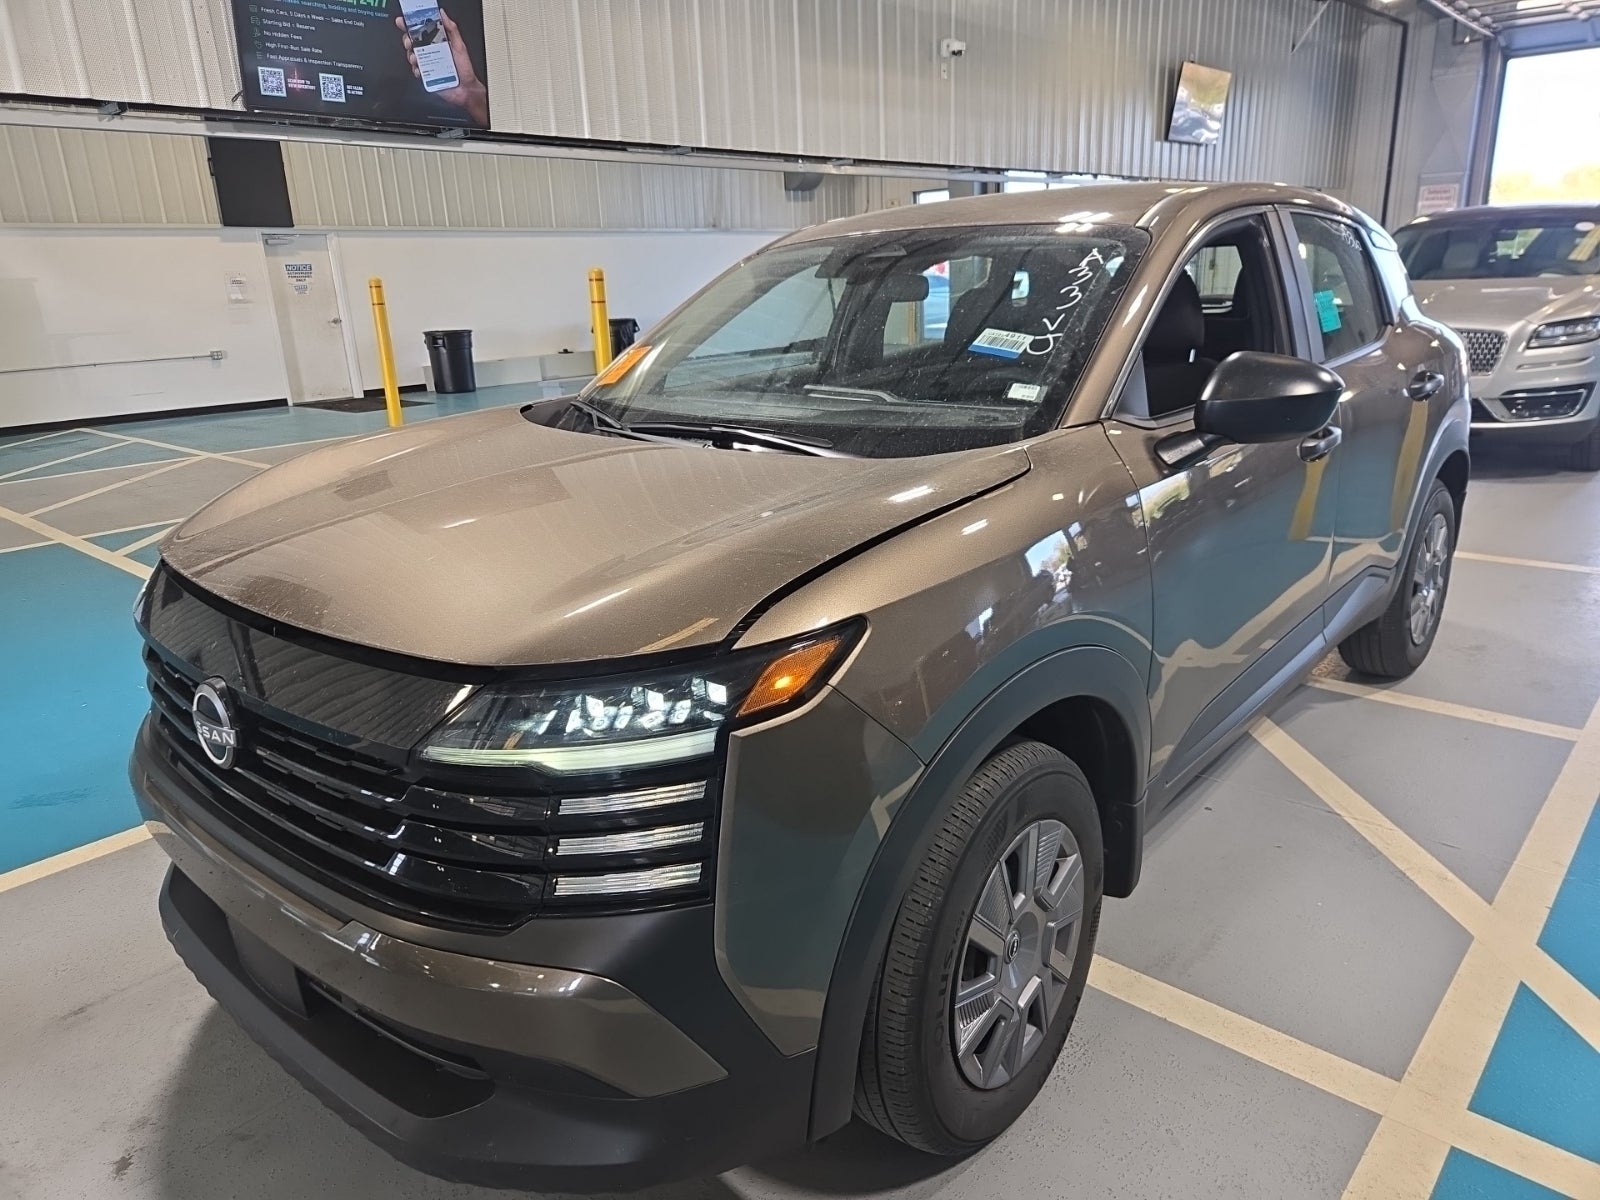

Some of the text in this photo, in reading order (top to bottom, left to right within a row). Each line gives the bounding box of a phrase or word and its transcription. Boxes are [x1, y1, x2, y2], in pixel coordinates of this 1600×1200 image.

[261, 6, 274, 14] Fresh
[353, 20, 365, 28] Daily
[262, 19, 282, 27] Starting
[296, 23, 316, 31] Reserve
[308, 58, 333, 66] Inspection
[333, 60, 363, 70] Transparency
